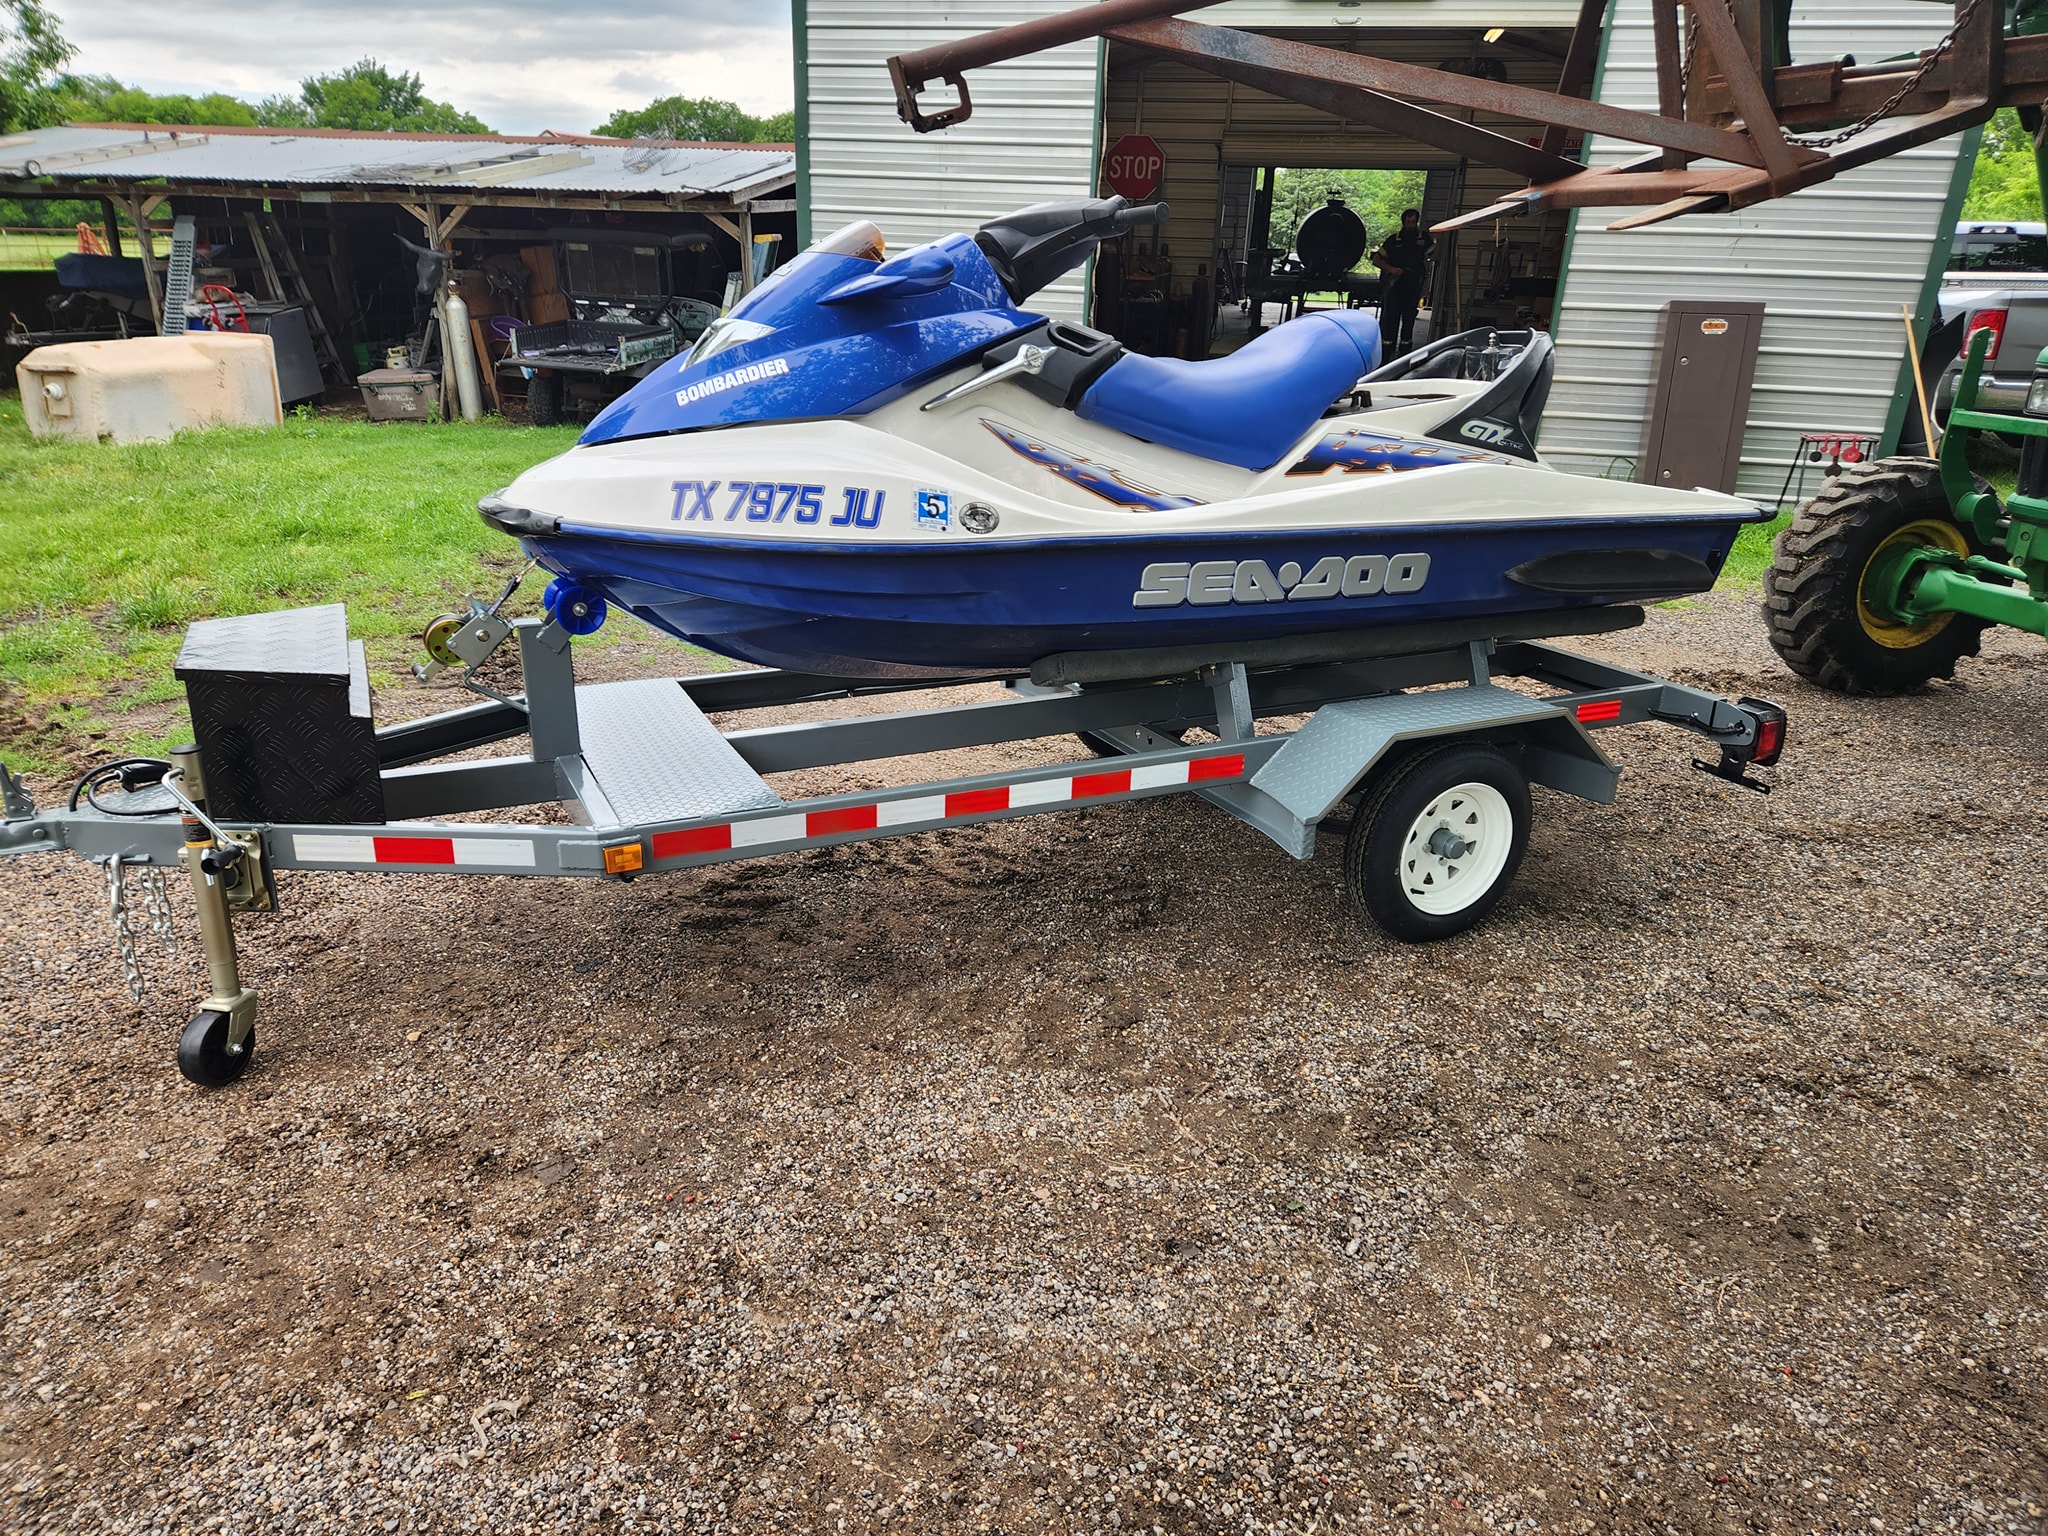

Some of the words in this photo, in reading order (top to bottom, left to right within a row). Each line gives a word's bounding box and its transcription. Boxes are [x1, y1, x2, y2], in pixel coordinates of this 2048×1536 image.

[1109, 155, 1161, 180] STOP
[675, 357, 790, 407] BOMBARDIER
[1460, 419, 1515, 445] GTX
[671, 480, 721, 522] TX
[724, 481, 825, 524] 7975
[829, 486, 886, 530] JU
[928, 495, 940, 518] 5
